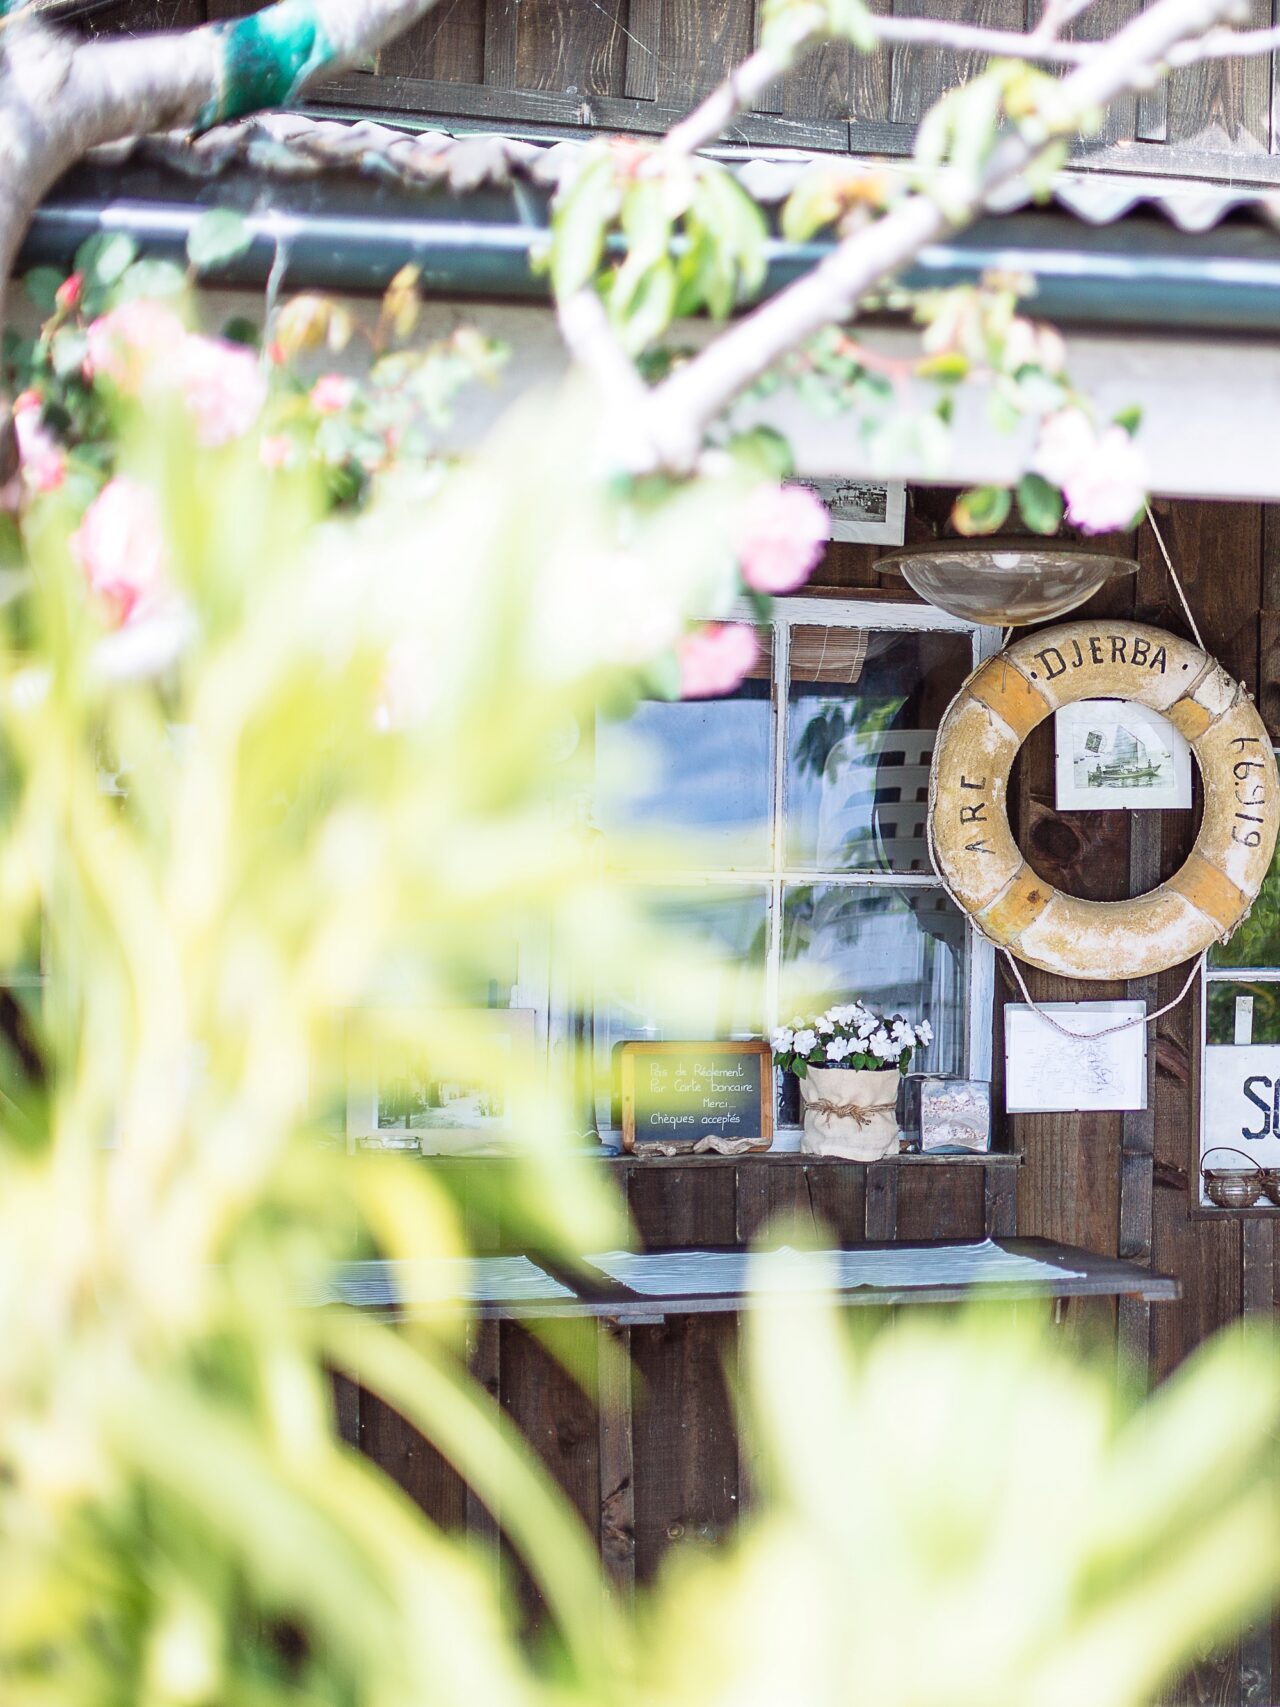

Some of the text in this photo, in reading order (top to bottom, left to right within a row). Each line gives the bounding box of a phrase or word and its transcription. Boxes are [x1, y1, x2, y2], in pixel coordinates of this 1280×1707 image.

[1034, 635, 1167, 680] DJERBA
[960, 775, 996, 855] ARC
[674, 1079, 702, 1093] Carte
[711, 1078, 753, 1092] bancaire
[650, 1112, 741, 1131] Chèques acceptés
